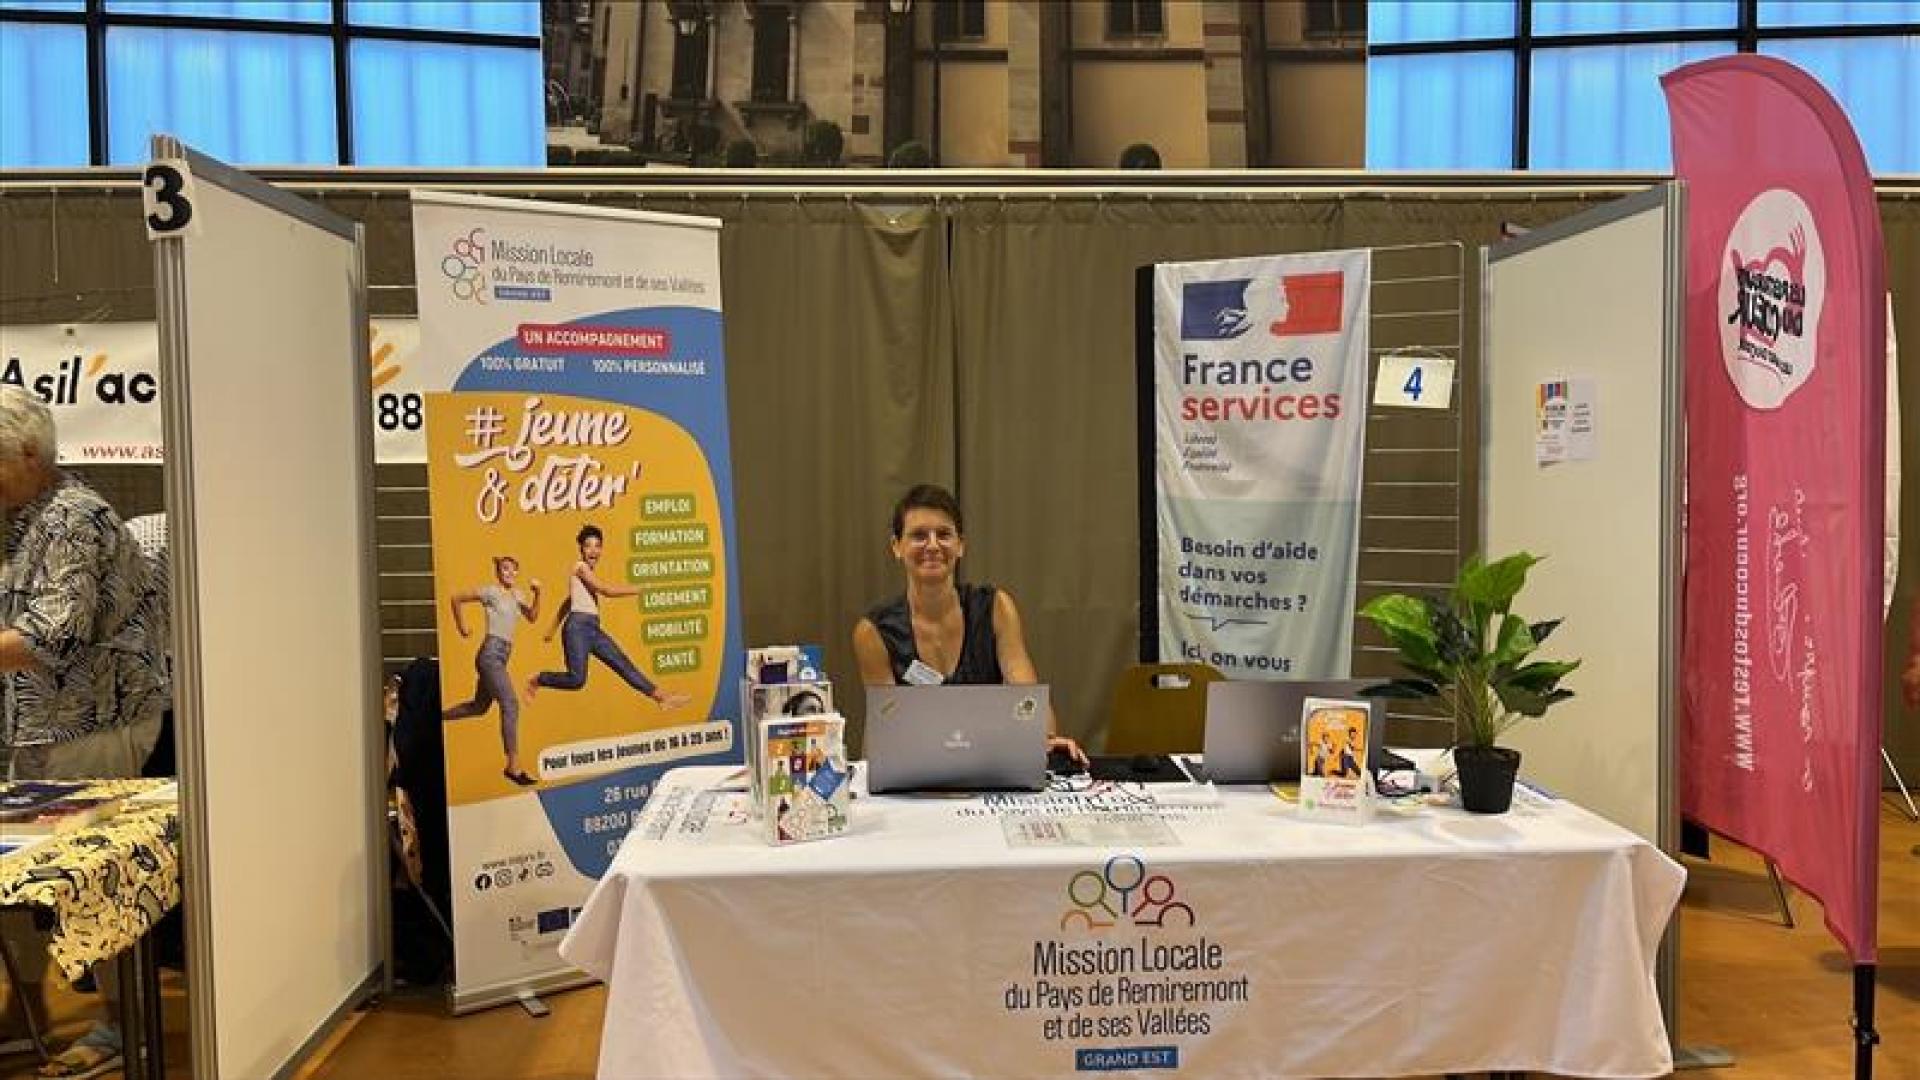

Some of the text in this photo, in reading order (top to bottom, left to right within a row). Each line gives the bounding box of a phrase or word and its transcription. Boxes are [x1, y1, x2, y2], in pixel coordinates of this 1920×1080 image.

[144, 165, 193, 232] 3
[492, 239, 594, 267] Mission Locale
[524, 330, 663, 348] UN ACCOMPAGNEMENT
[481, 357, 511, 371] 100%
[515, 357, 565, 373] GRATUIT
[593, 359, 622, 374] 100%
[1182, 354, 1313, 385] France
[1403, 366, 1423, 400] 4
[378, 393, 423, 430] 88
[1181, 385, 1341, 422] services
[477, 467, 509, 523] &
[645, 498, 691, 515] EMPLOI
[635, 528, 704, 546] FORMATION
[1181, 537, 1319, 560] Besoin d'aide
[633, 558, 709, 577] ORIENTATION
[1178, 561, 1268, 584] dans vos
[645, 588, 707, 608] LOGEMENT
[1180, 585, 1292, 611] démarches
[1211, 650, 1237, 666] on
[1243, 655, 1292, 673] vous
[543, 756, 567, 771] Pour
[571, 750, 596, 766] tous
[624, 784, 649, 800] rue
[1033, 936, 1223, 978] Mission Locale
[1005, 974, 1249, 1012] du Pays de Remiremont
[1044, 1006, 1211, 1041] et de ses Vallées
[1084, 1052, 1139, 1068] GRAND
